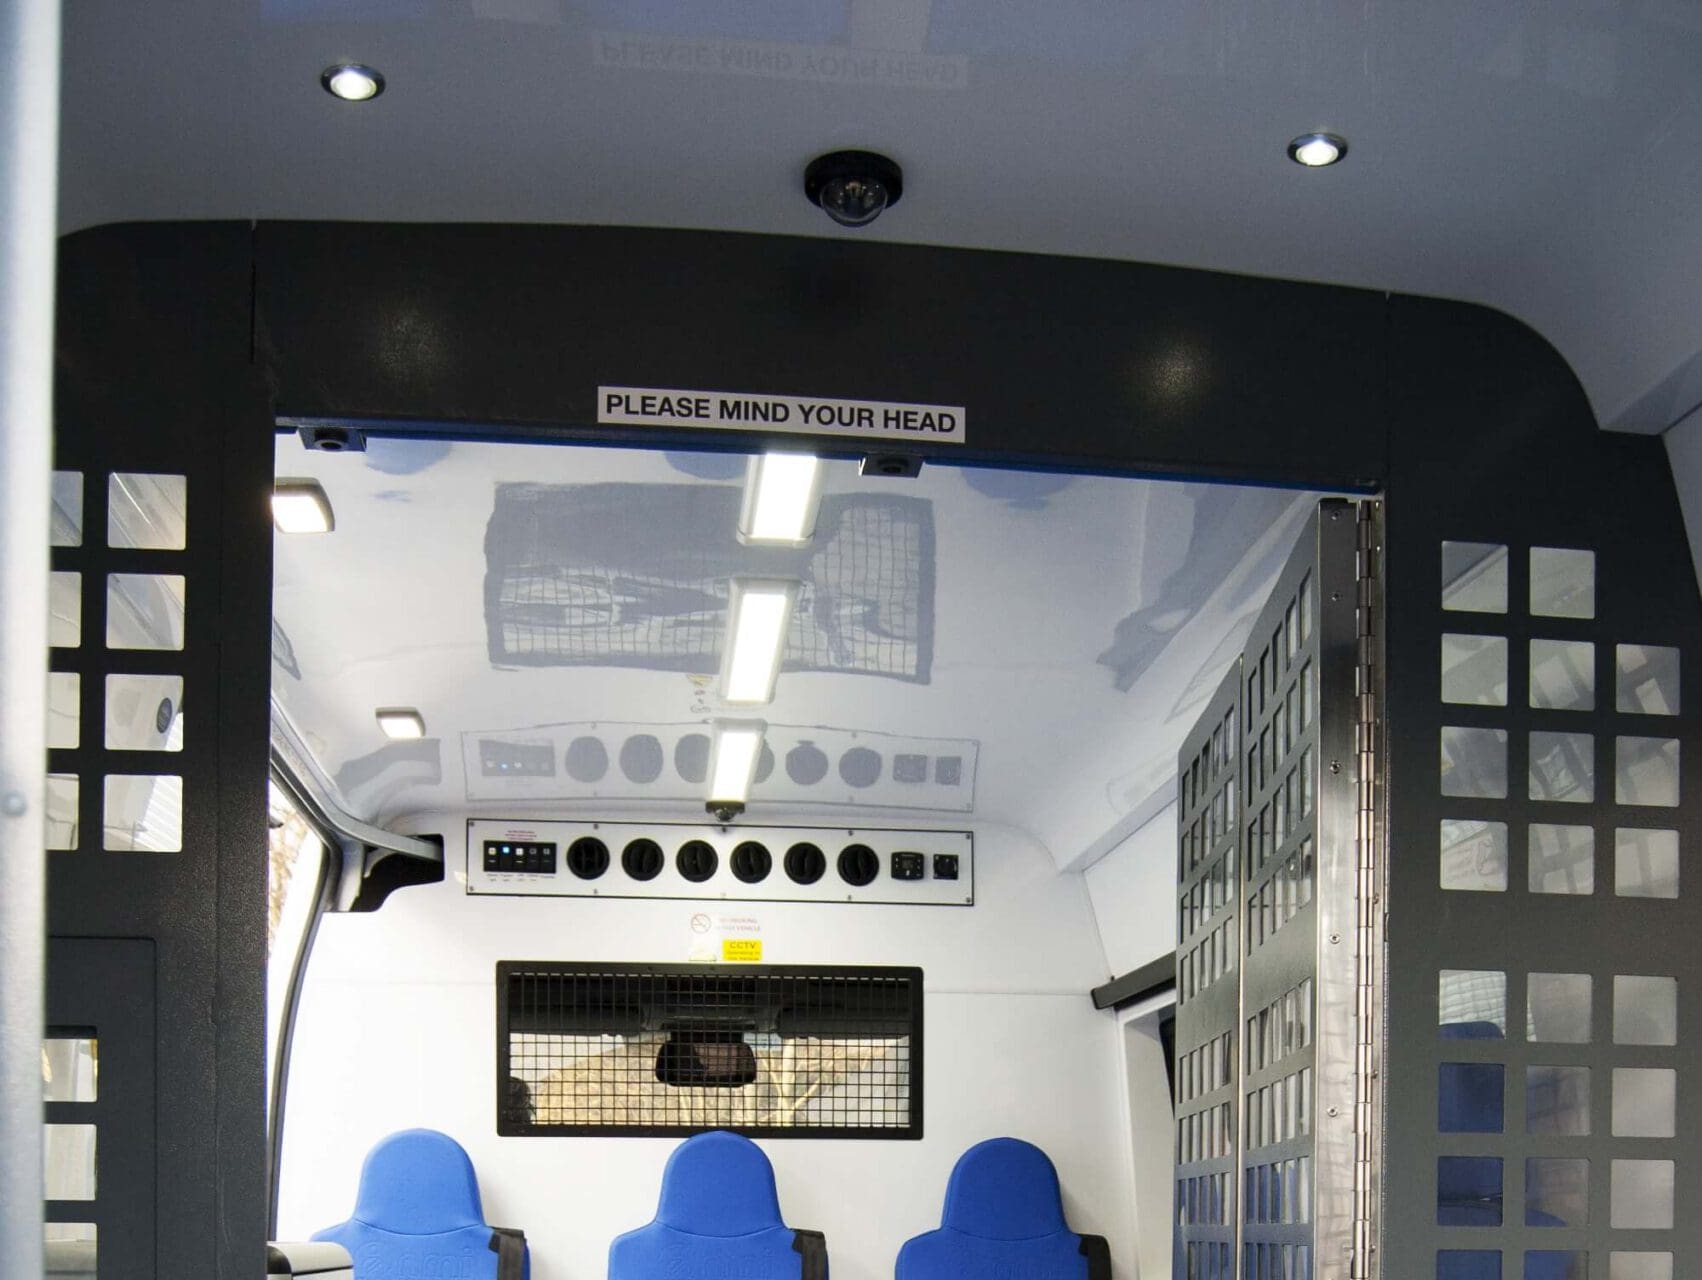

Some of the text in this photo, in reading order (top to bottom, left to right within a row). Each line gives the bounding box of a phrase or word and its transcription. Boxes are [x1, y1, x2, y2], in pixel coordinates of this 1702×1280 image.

[606, 393, 956, 433] PLEASE MIND YOUR HEAD
[729, 941, 757, 949] CCTV
